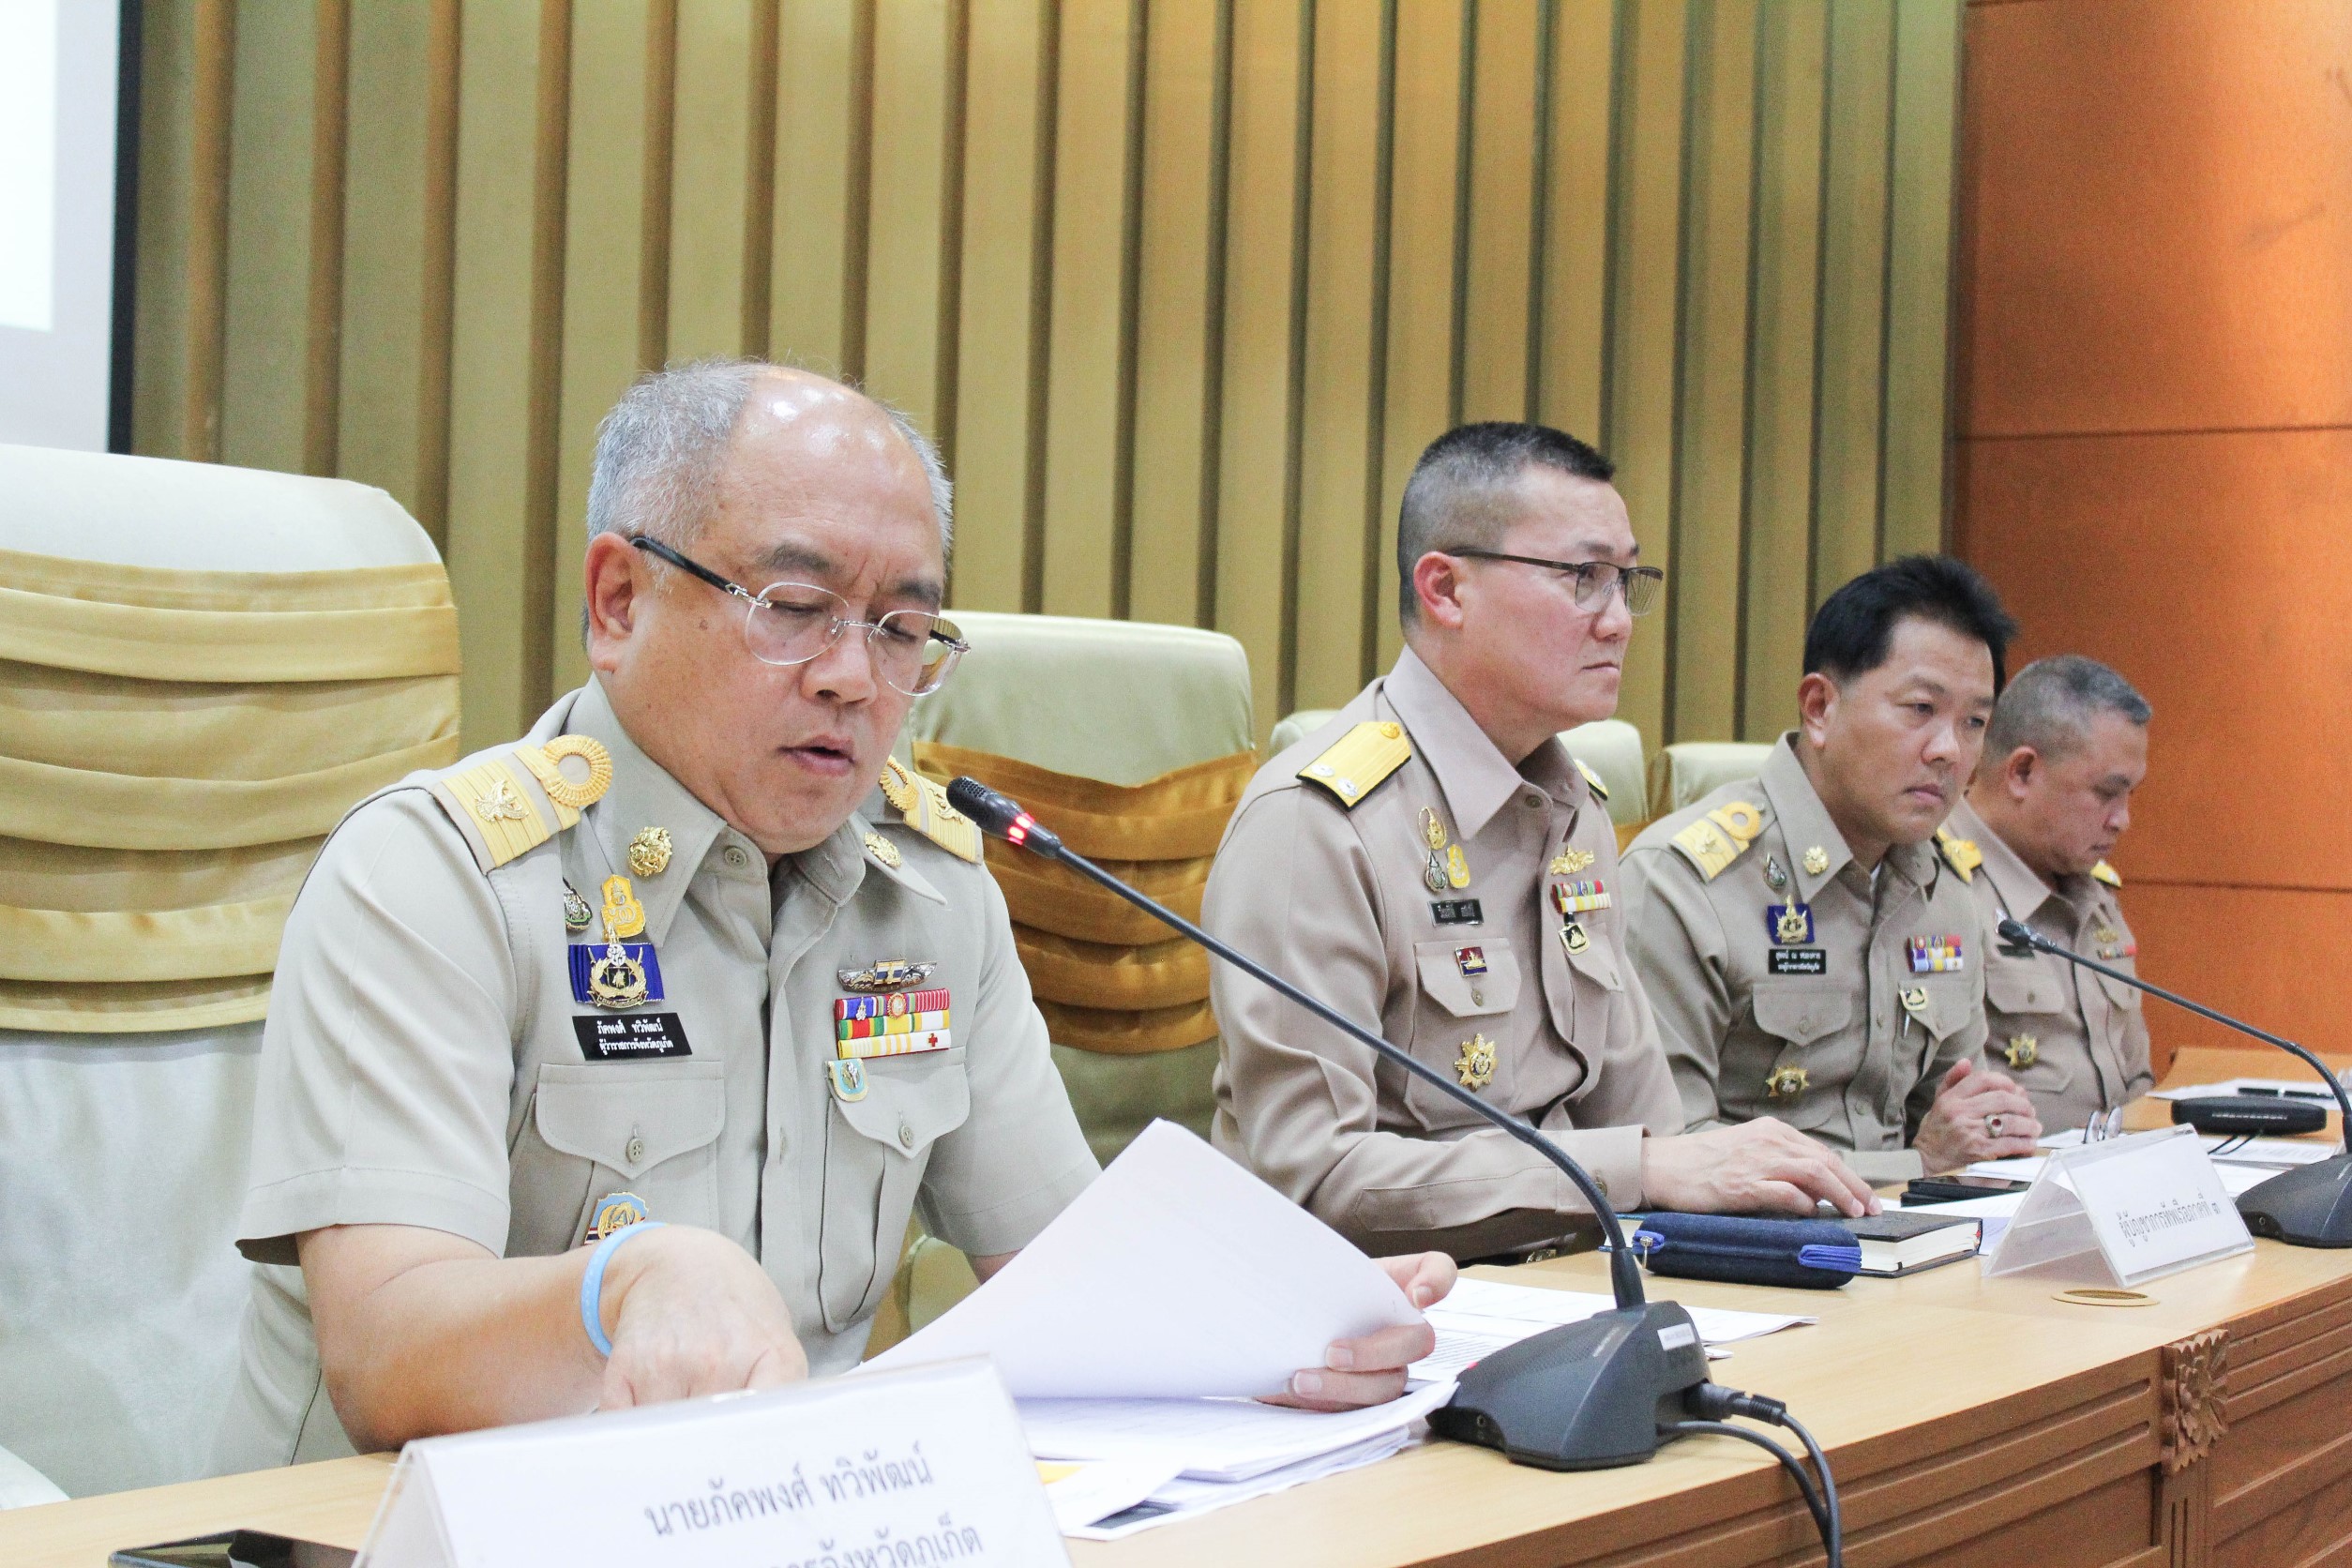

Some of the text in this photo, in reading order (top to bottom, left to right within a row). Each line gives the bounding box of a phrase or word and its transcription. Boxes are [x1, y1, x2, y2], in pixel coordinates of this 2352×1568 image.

[644, 1440, 934, 1537] นายภัคพงศ์ ทวิพัฒน์
